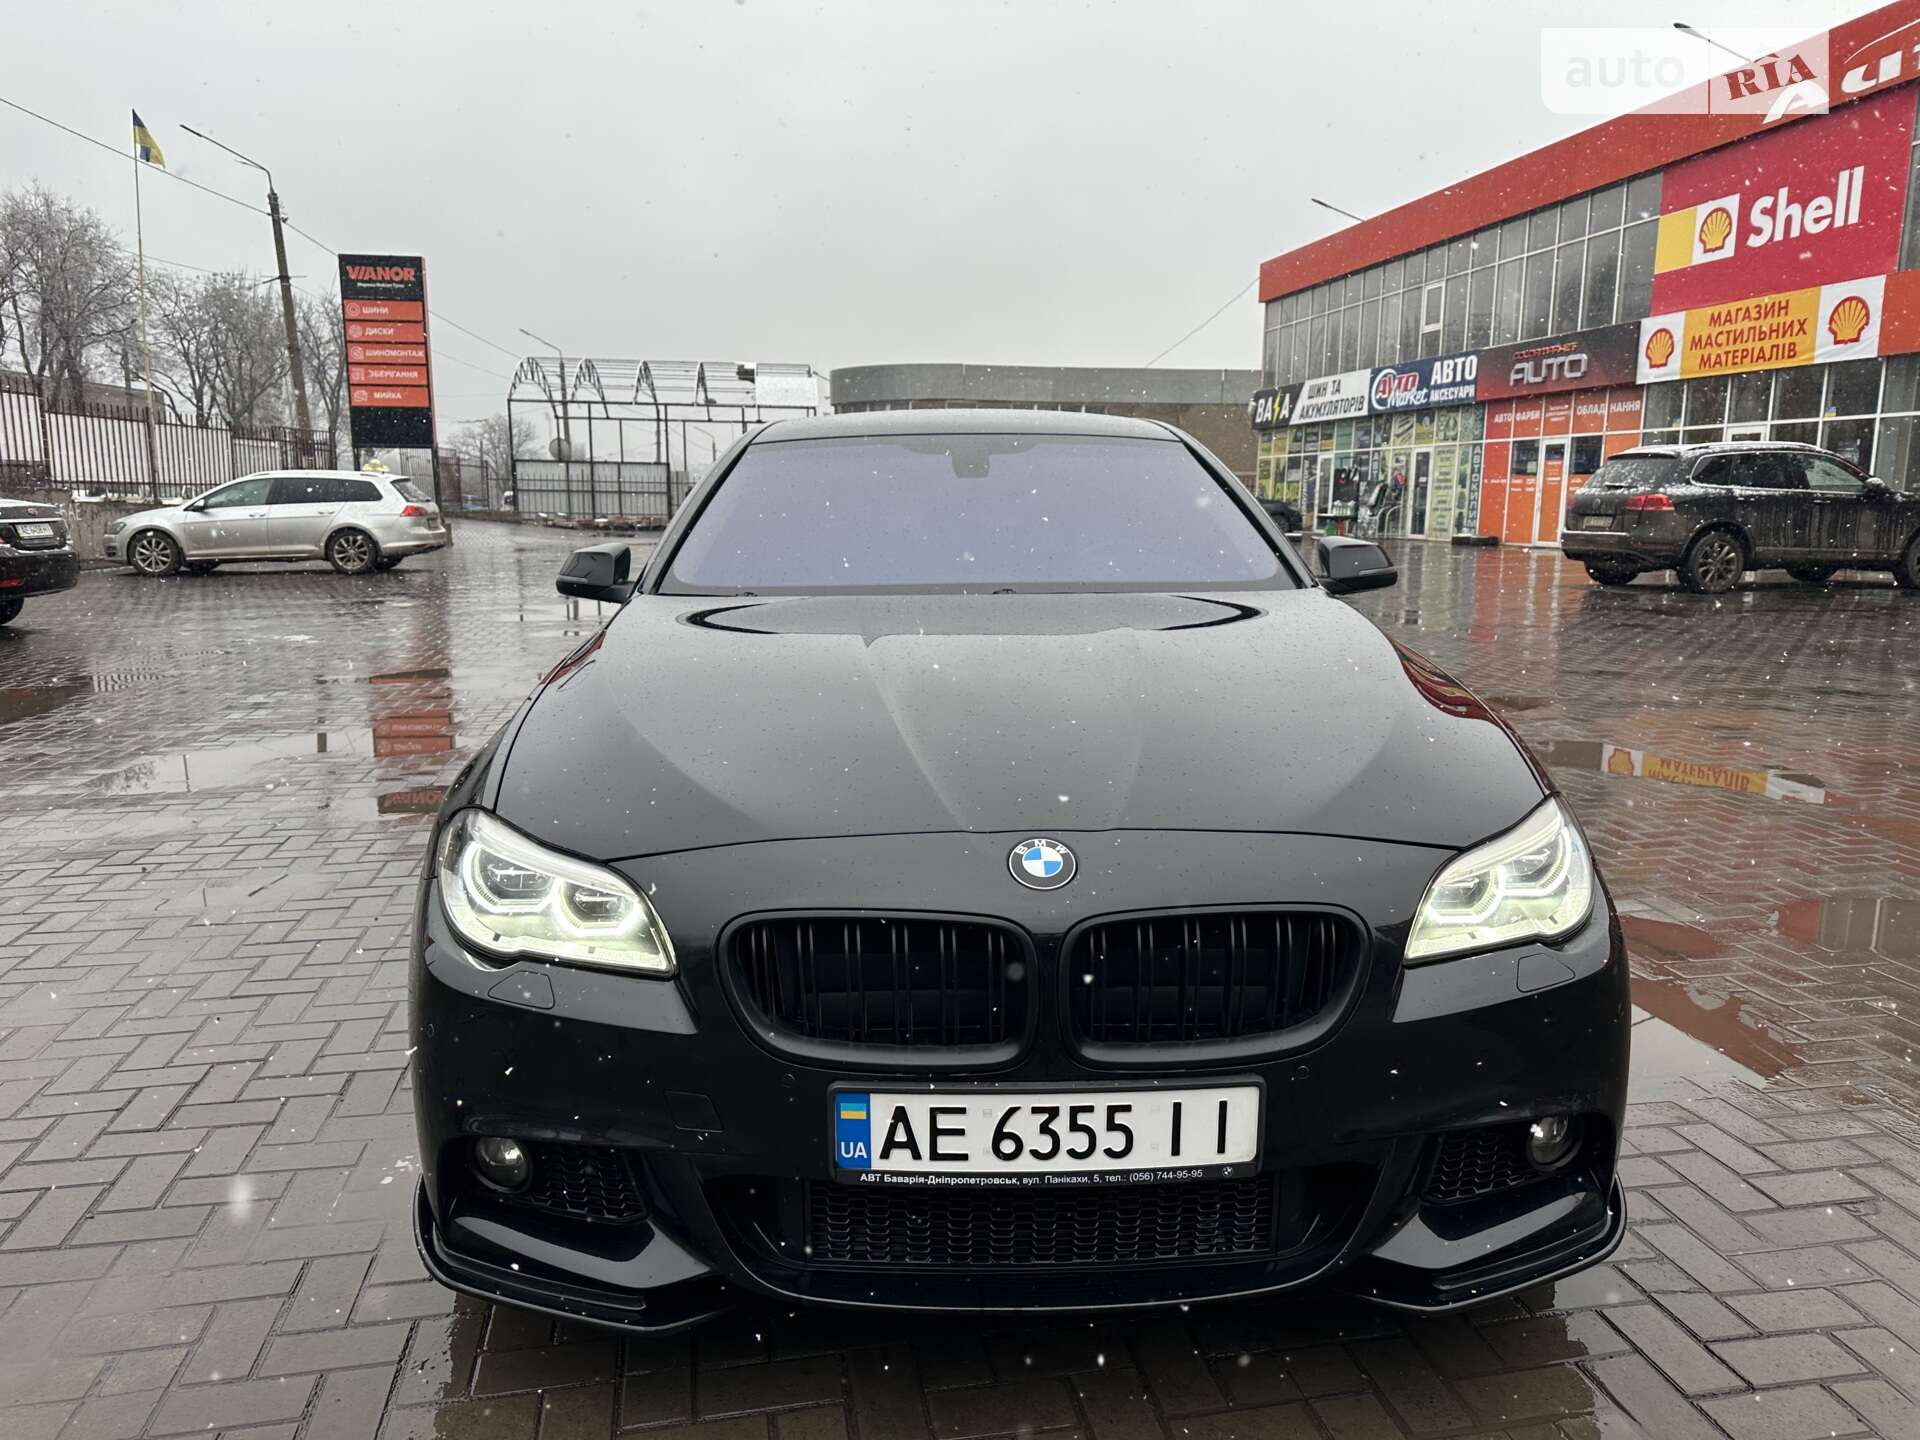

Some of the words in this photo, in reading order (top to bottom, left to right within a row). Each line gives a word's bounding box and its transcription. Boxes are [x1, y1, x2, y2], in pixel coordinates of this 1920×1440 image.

[1746, 165, 1864, 247] Shell
[346, 266, 416, 281] VIANOR
[1709, 299, 1789, 327] МАГАЗИН
[1690, 318, 1807, 351] МАСТИЛЬНИХ
[1698, 342, 1797, 369] МАТЕРІАЛІВ
[1431, 355, 1478, 385] АВТО
[1509, 353, 1588, 386] AUTO
[1308, 381, 1328, 399] ШИН
[1331, 379, 1341, 395] ТА
[1429, 384, 1475, 402] АКСЕСУАРИ
[1299, 395, 1365, 419] АКУМУЛЯТОРІВ
[879, 1105, 969, 1161] AE
[991, 1104, 1134, 1162] 6355
[841, 1142, 867, 1159] UA
[859, 1173, 881, 1183] АВТ
[884, 1174, 1020, 1186] Баварія-Дніпропетровськ,
[1022, 1176, 1042, 1186] вул.
[1129, 1172, 1154, 1183] (056)
[1156, 1169, 1203, 1180] 744-95-95
